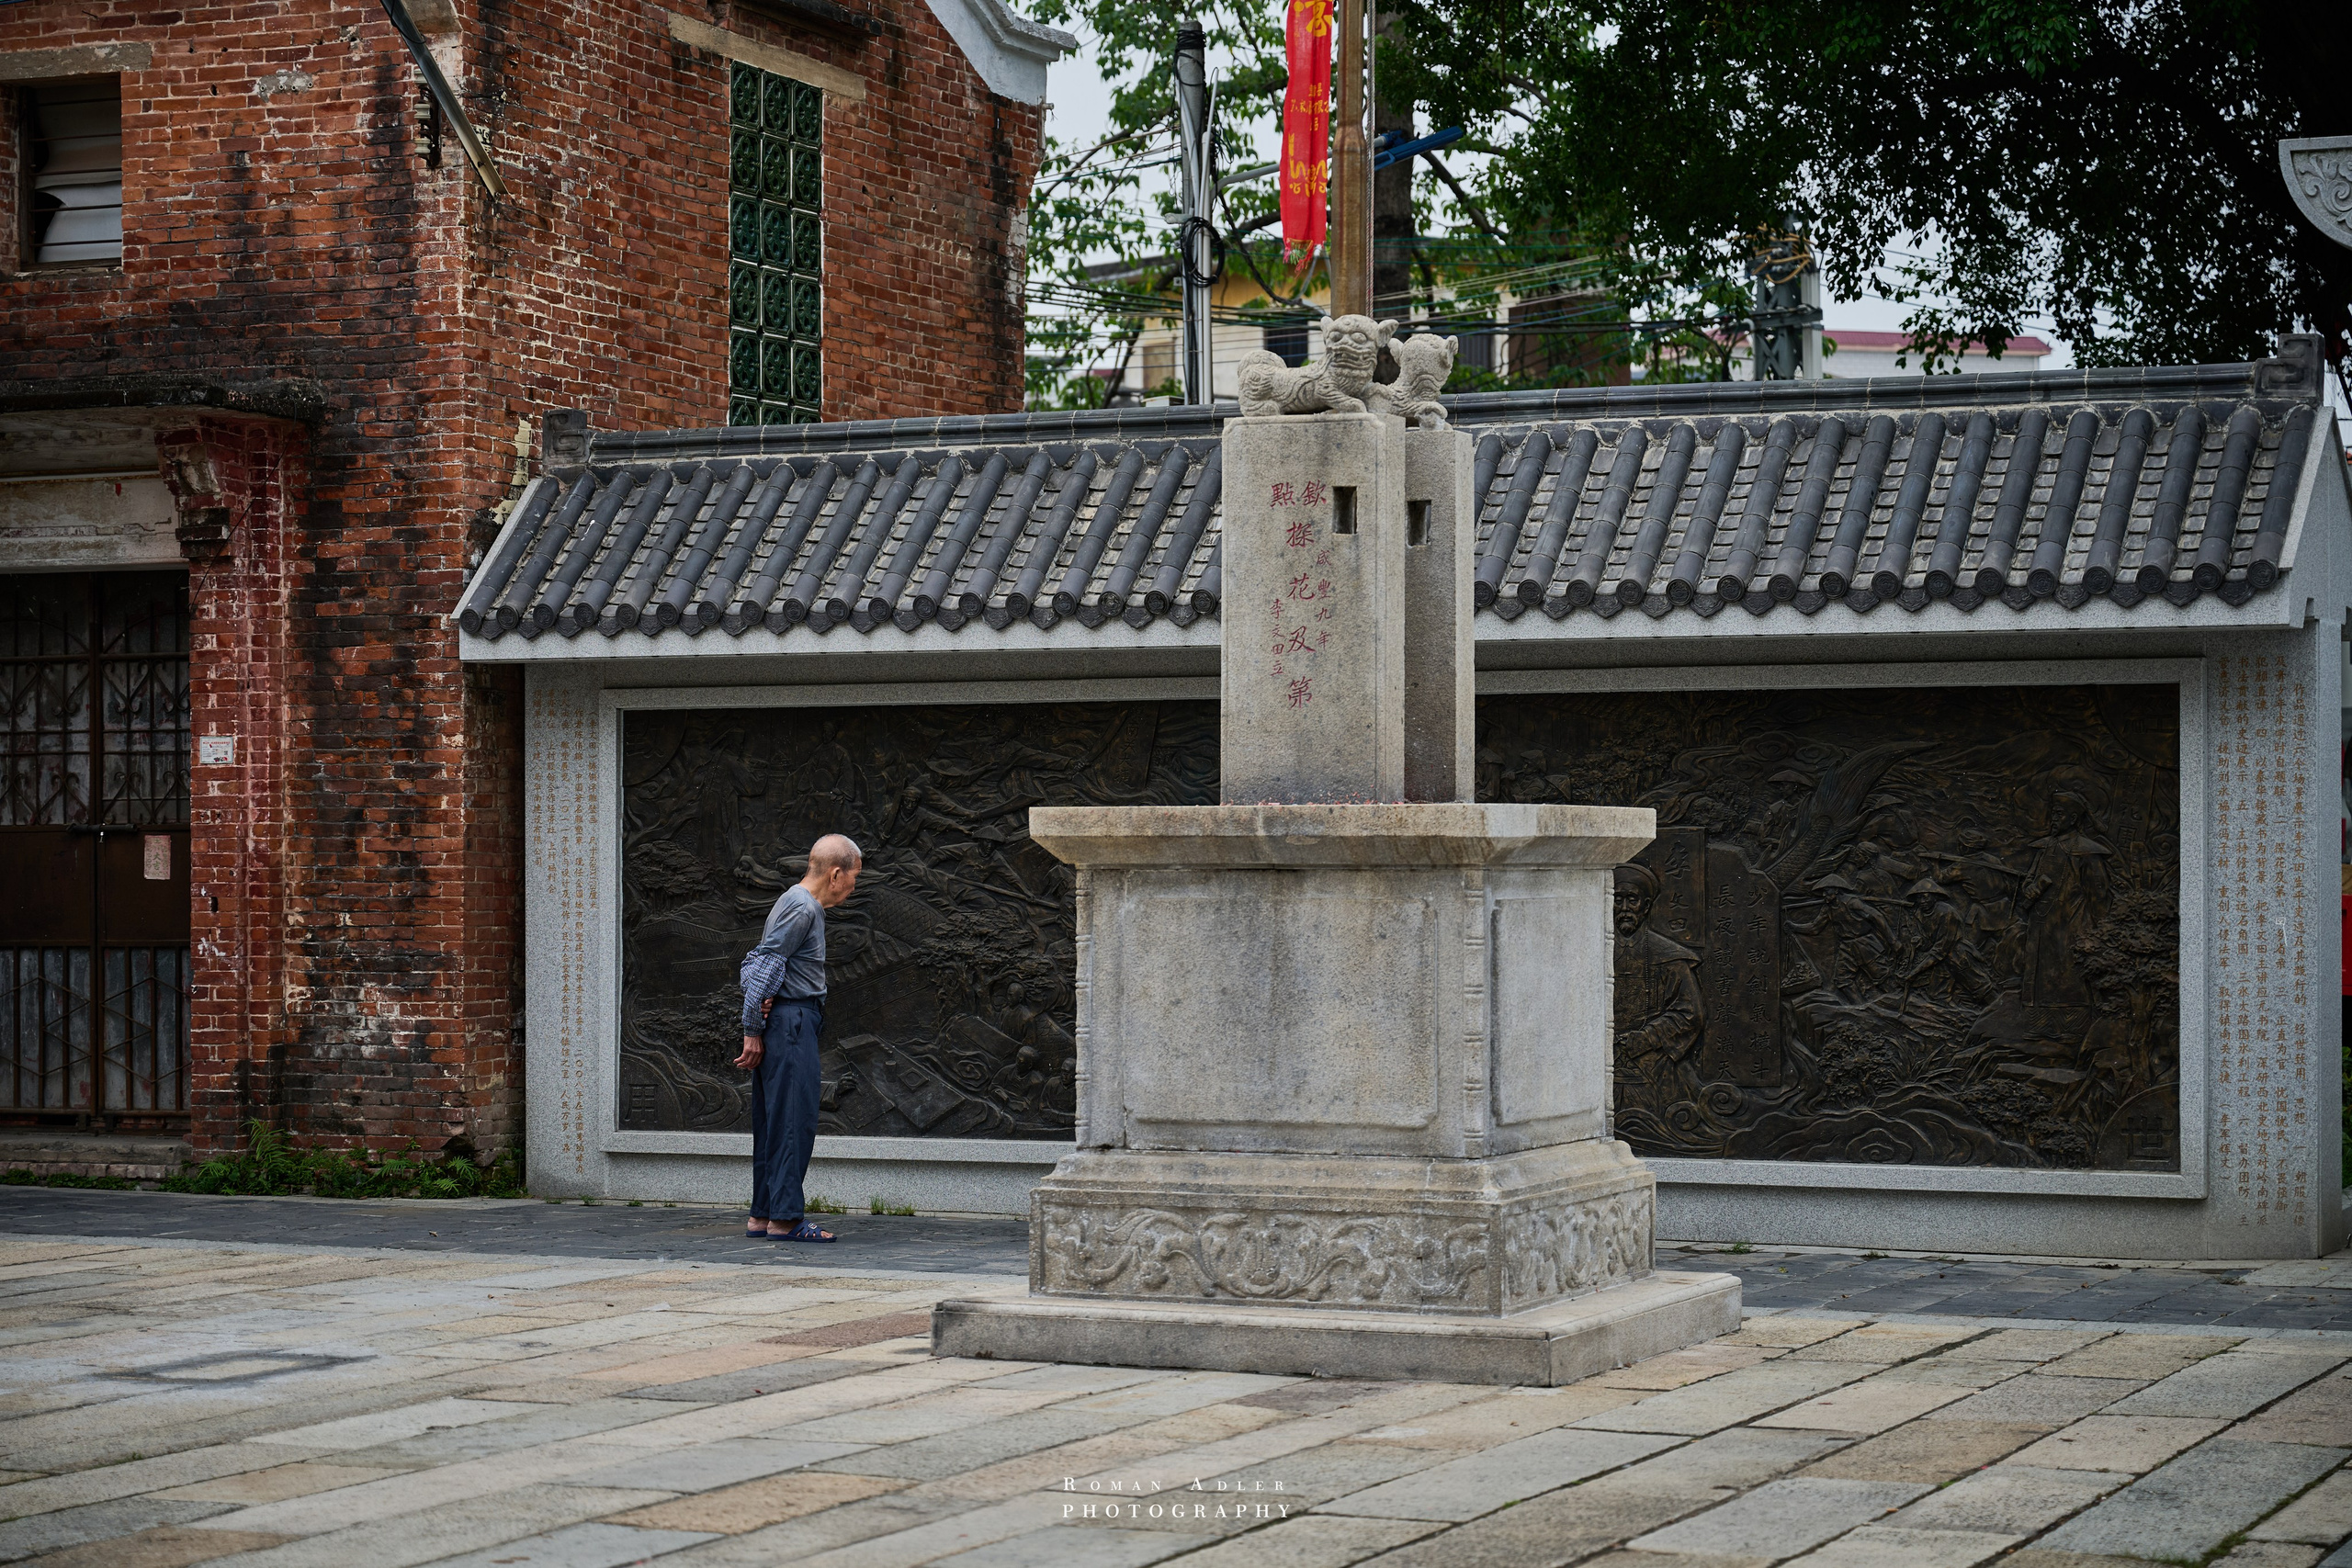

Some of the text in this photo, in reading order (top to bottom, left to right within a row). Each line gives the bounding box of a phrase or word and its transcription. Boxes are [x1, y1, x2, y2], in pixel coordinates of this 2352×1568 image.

[1269, 598, 1285, 677] 李文田立
[624, 1083, 660, 1123] 用
[2120, 1115, 2175, 1164] 世
